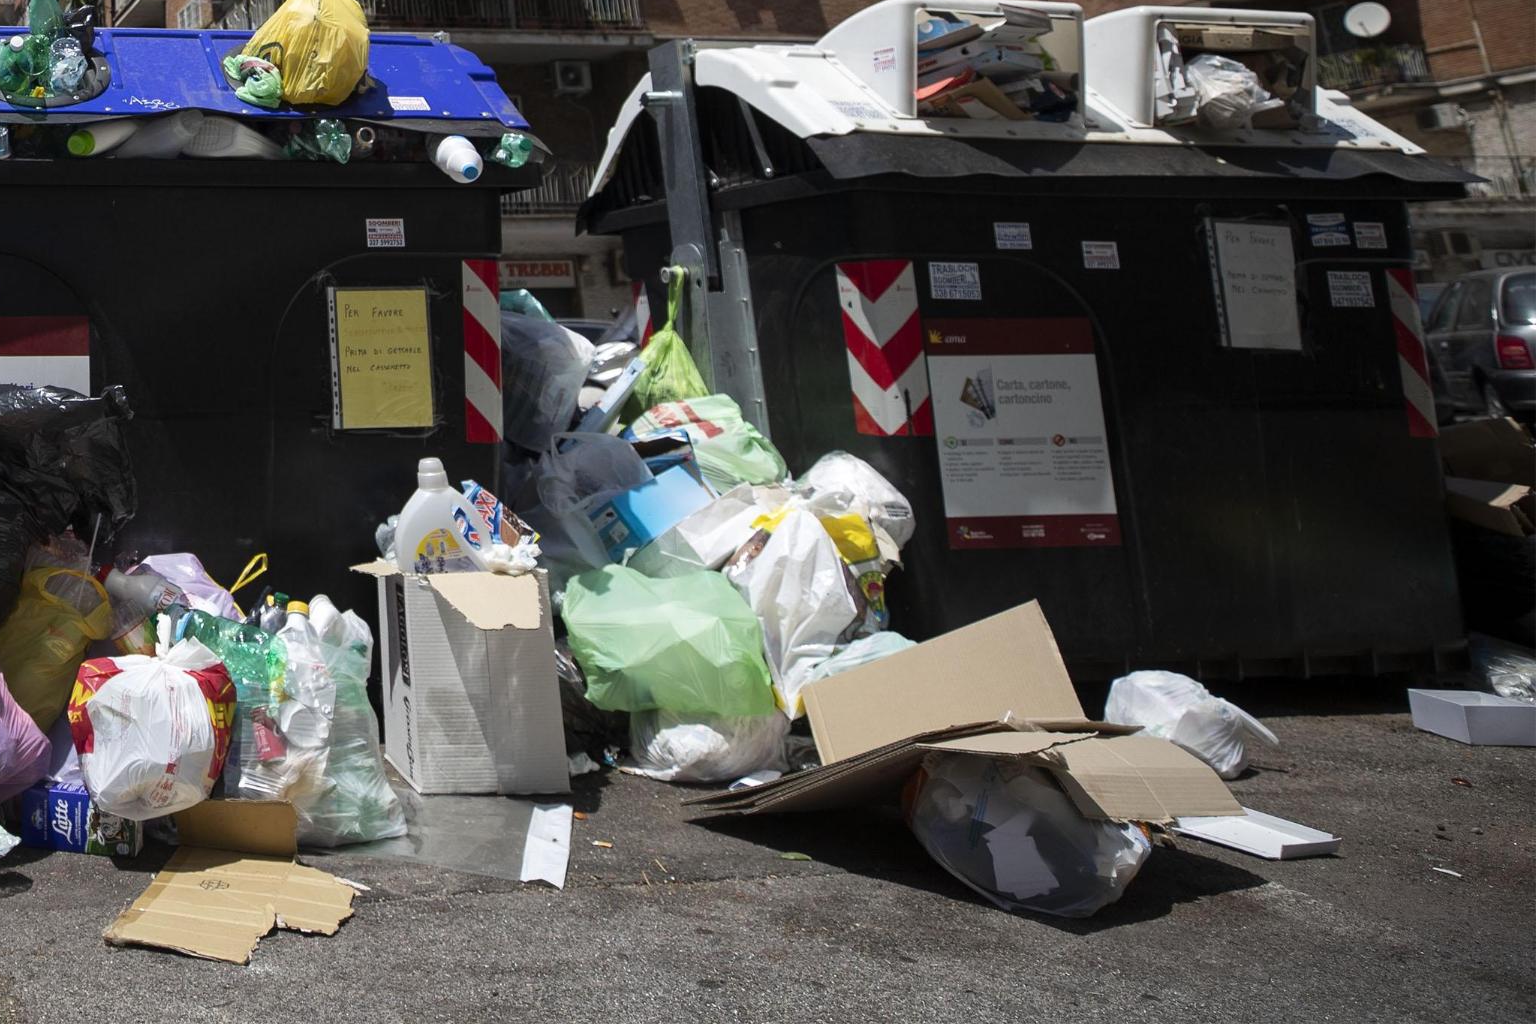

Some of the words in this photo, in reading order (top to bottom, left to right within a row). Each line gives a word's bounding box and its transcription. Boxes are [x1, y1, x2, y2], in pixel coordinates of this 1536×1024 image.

[344, 303, 359, 317] PER
[372, 306, 403, 317] FAVORE
[944, 335, 966, 344] ama
[345, 345, 367, 357] PRIMA
[346, 365, 360, 374] NEL
[996, 379, 1027, 392] Carta,
[1028, 379, 1072, 392] cartone,
[998, 393, 1053, 405] cartoncino
[52, 798, 73, 846] Latte
